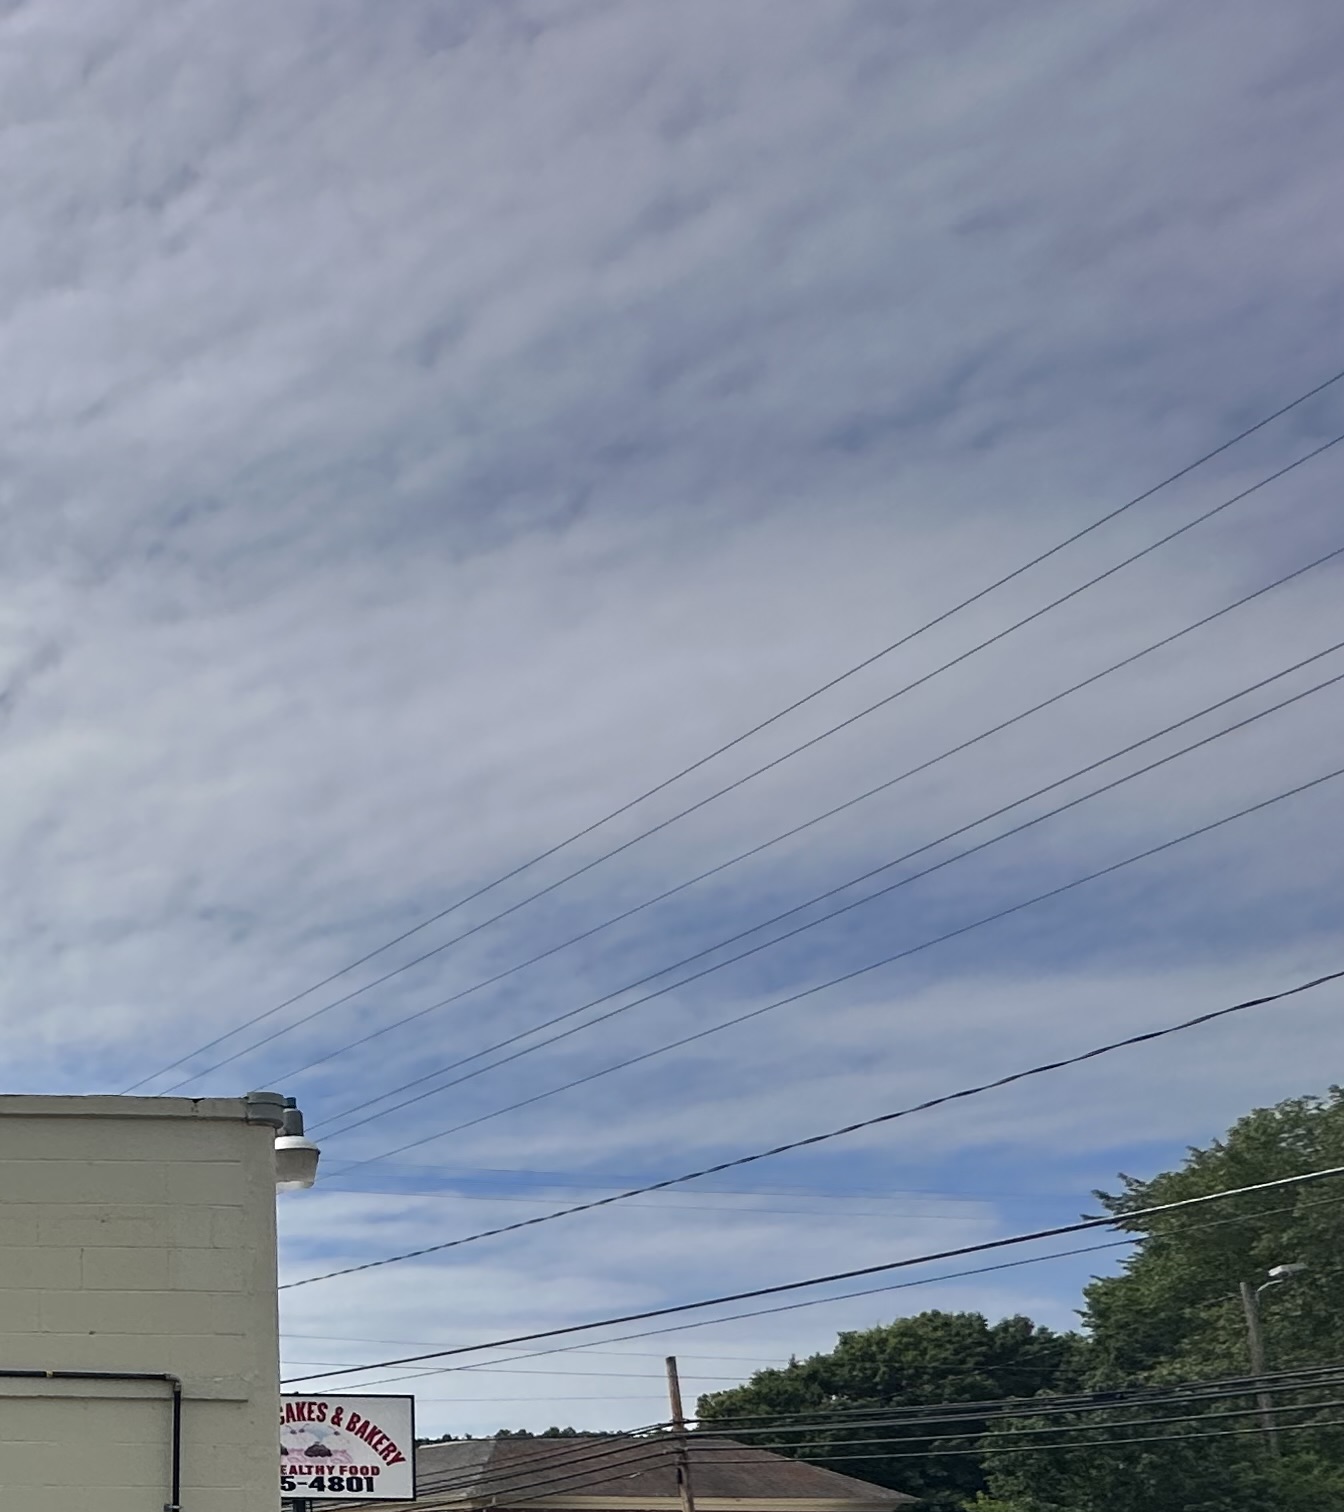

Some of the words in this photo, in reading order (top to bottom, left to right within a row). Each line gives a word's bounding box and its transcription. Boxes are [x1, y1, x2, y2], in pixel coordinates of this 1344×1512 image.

[331, 1407, 344, 1427] &
[346, 1412, 406, 1466] BAKERY
[340, 1466, 380, 1475] FOOD
[280, 1476, 374, 1492] 5-4801
